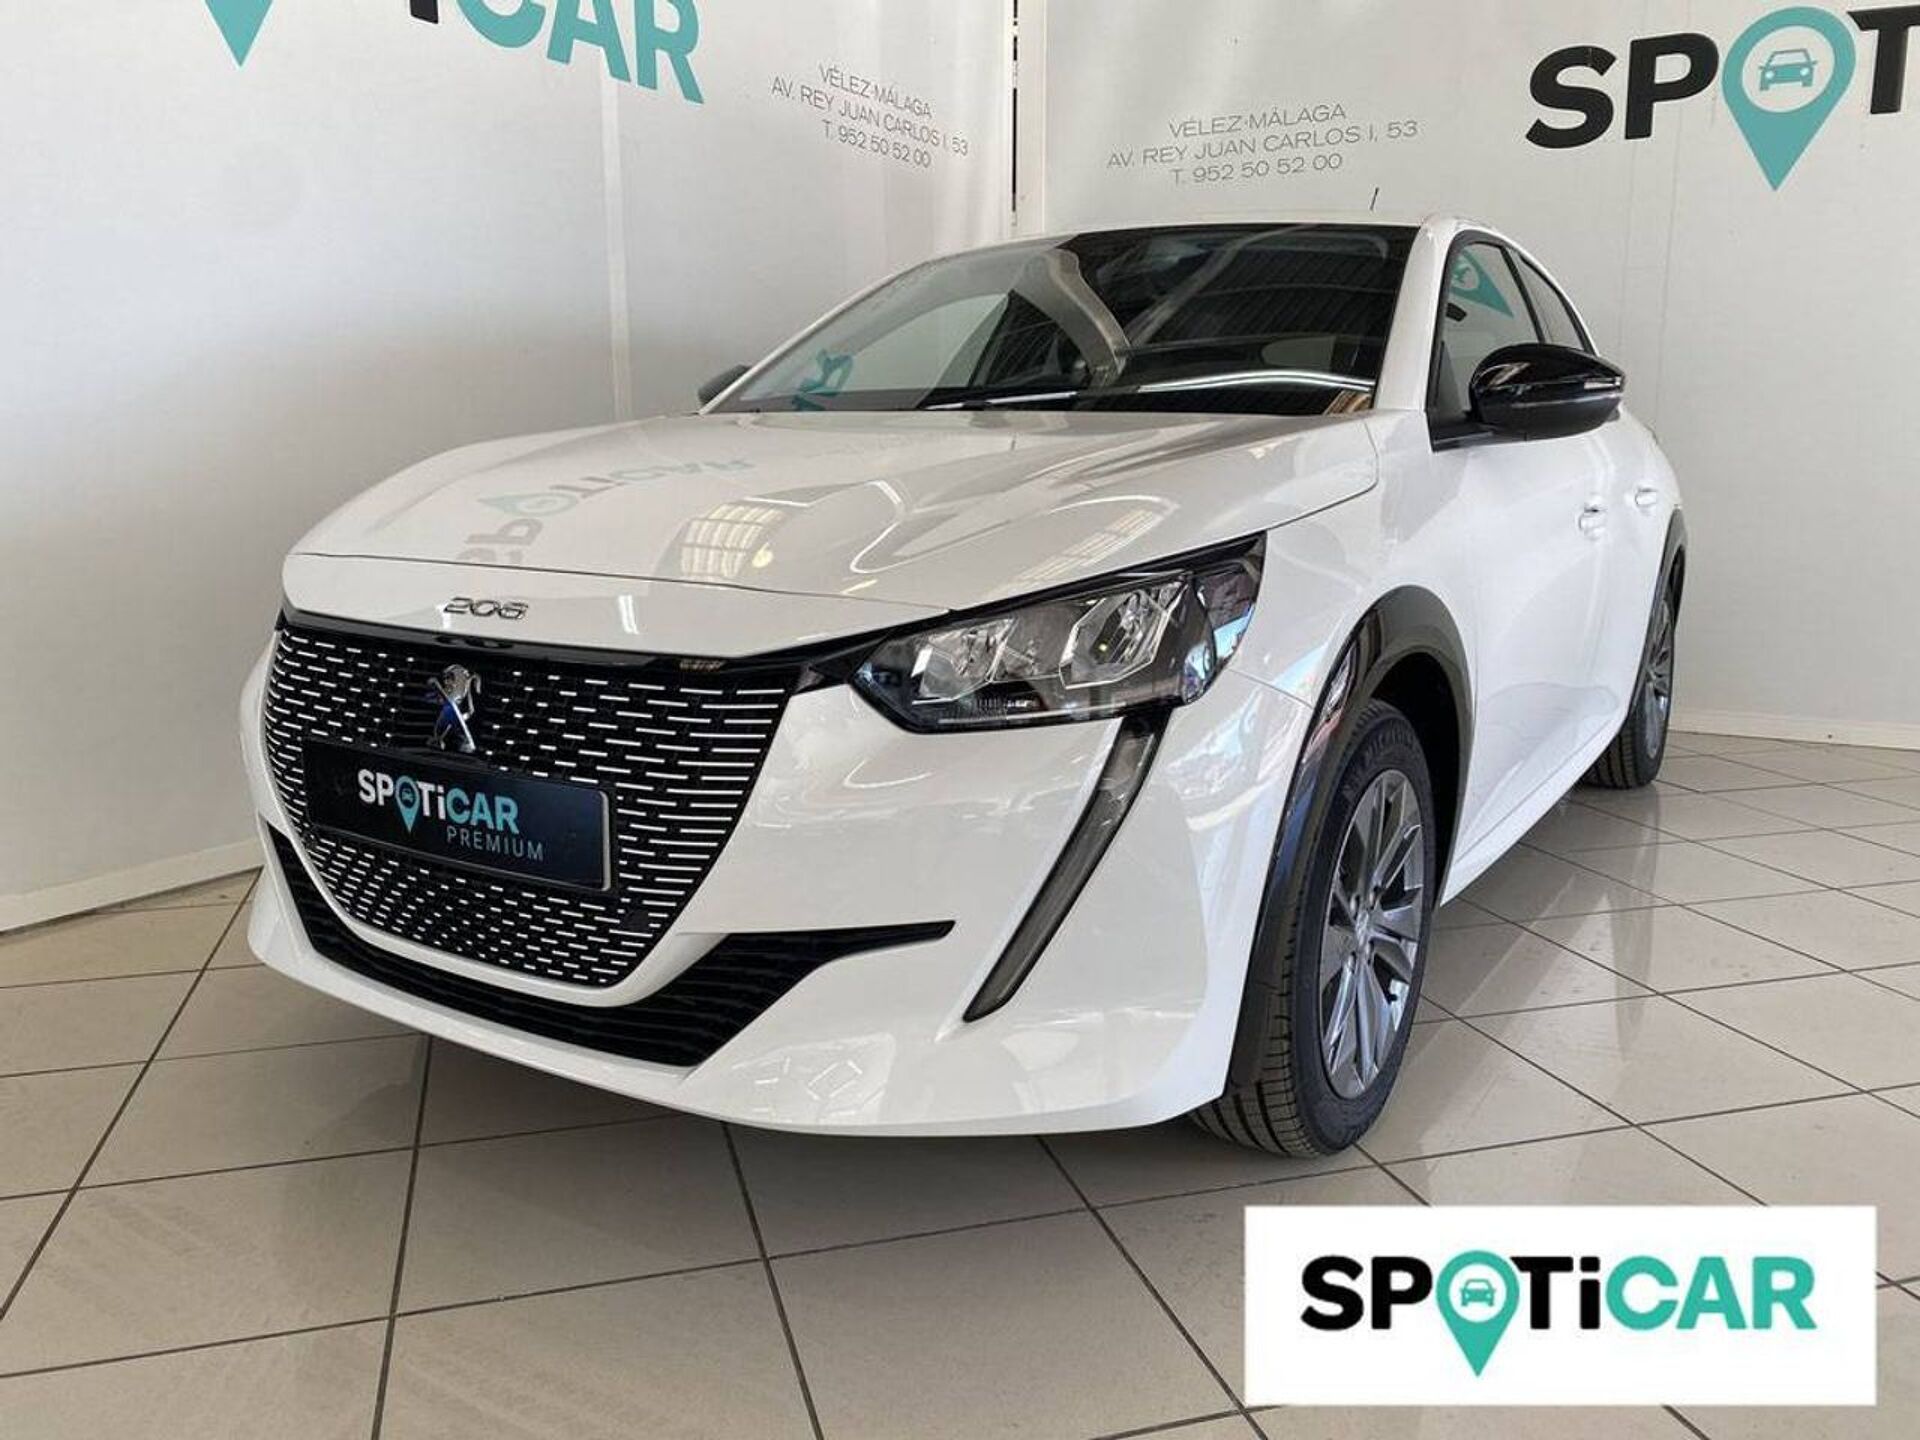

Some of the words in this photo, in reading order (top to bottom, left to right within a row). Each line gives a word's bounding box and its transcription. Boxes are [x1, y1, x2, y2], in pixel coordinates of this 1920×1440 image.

[800, 84, 835, 111] REY
[838, 100, 880, 128] JUAN
[884, 112, 941, 147] CARLOS
[951, 136, 969, 156] 53
[838, 125, 867, 150] 952
[870, 135, 890, 155] 50
[893, 141, 911, 163] 52
[913, 148, 932, 169] 00
[1106, 149, 1135, 168] AV.
[1142, 144, 1188, 165] REY
[1194, 137, 1257, 160] JUAN
[1263, 125, 1361, 152] CARLOS
[1387, 120, 1418, 139] 53
[1192, 164, 1235, 184] 952
[1241, 160, 1270, 179] 50
[1276, 156, 1305, 175] 52
[1312, 152, 1343, 171] 00
[446, 825, 544, 862] PREMIUM
